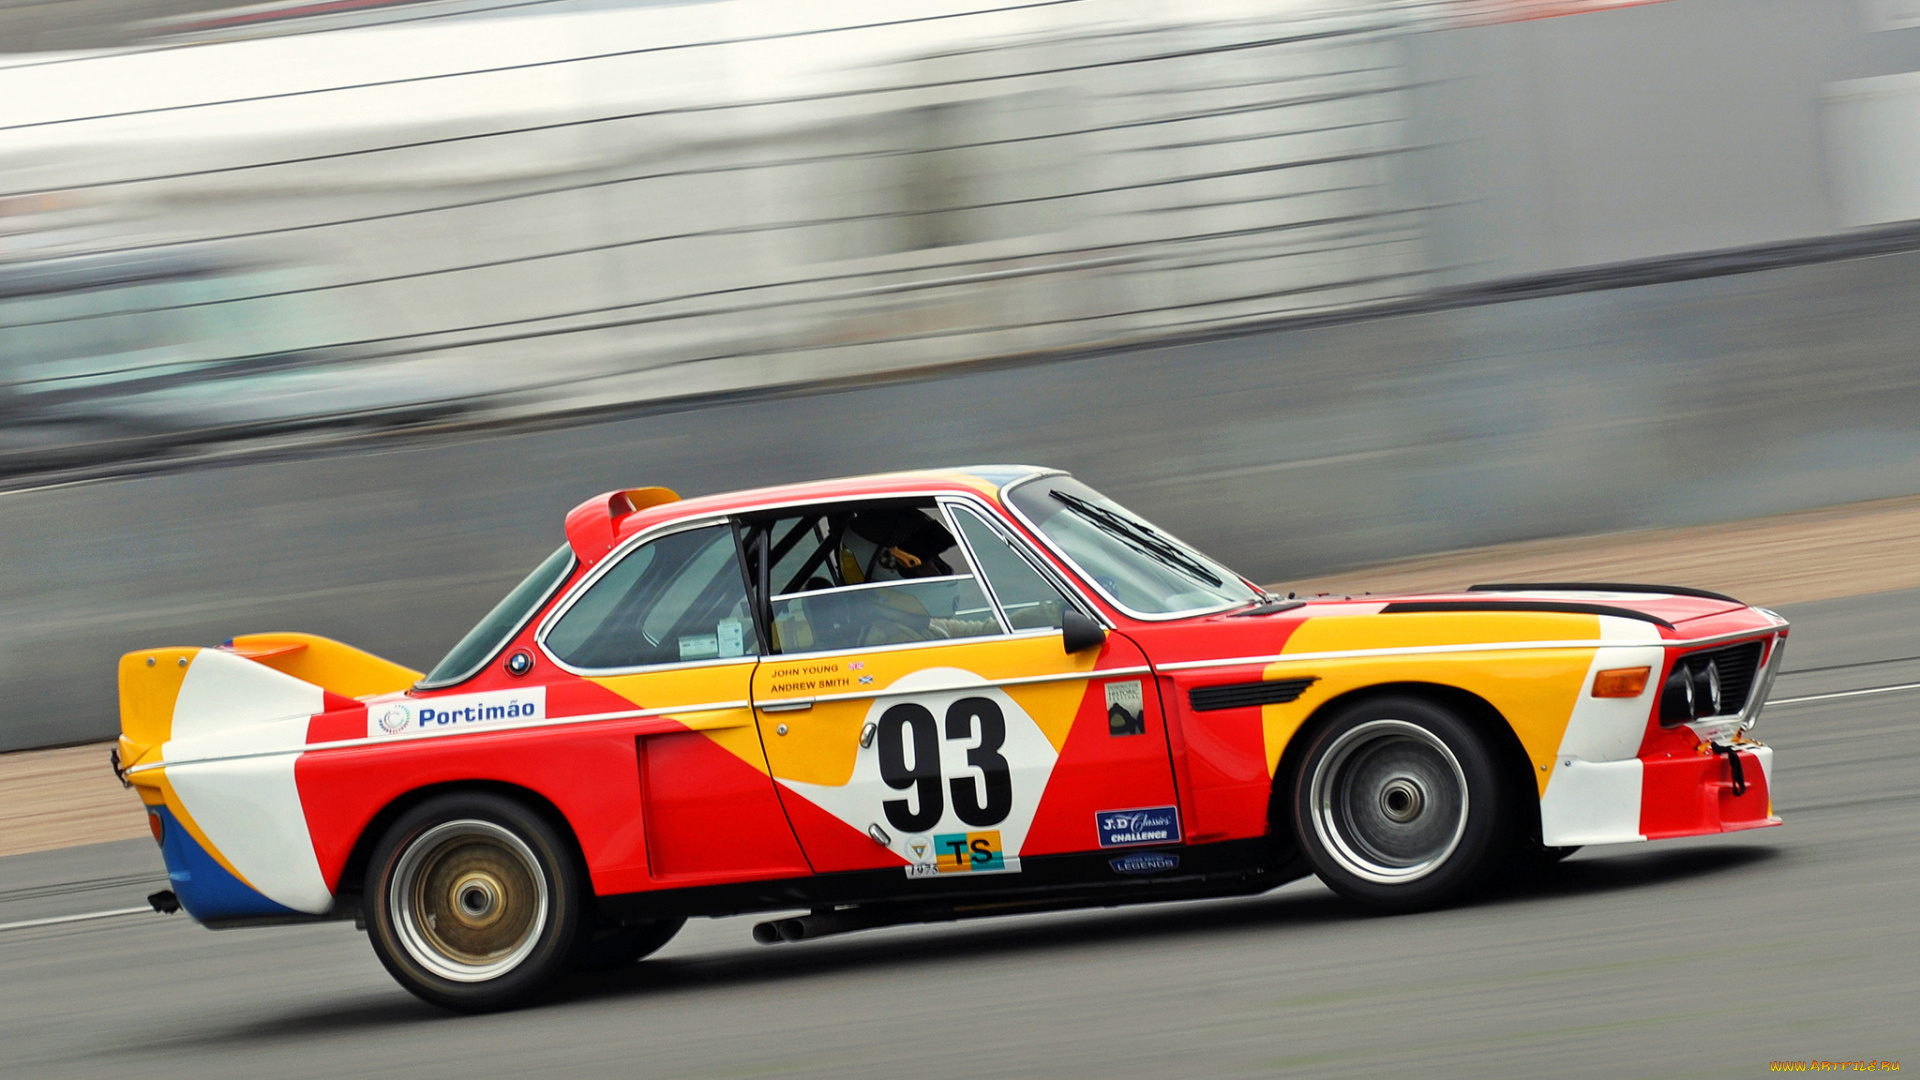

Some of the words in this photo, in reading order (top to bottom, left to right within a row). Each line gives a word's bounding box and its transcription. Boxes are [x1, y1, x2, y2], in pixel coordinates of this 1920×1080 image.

[771, 667, 800, 679] JOHN
[802, 664, 839, 676] YOUNG
[771, 680, 816, 693] ANDREW
[818, 678, 850, 689] SMITH
[419, 699, 535, 727] Portimão
[877, 696, 1013, 833] 93
[1110, 830, 1168, 843] CHALLENGE
[946, 838, 993, 866] TS
[1117, 858, 1174, 872] LEGENDS
